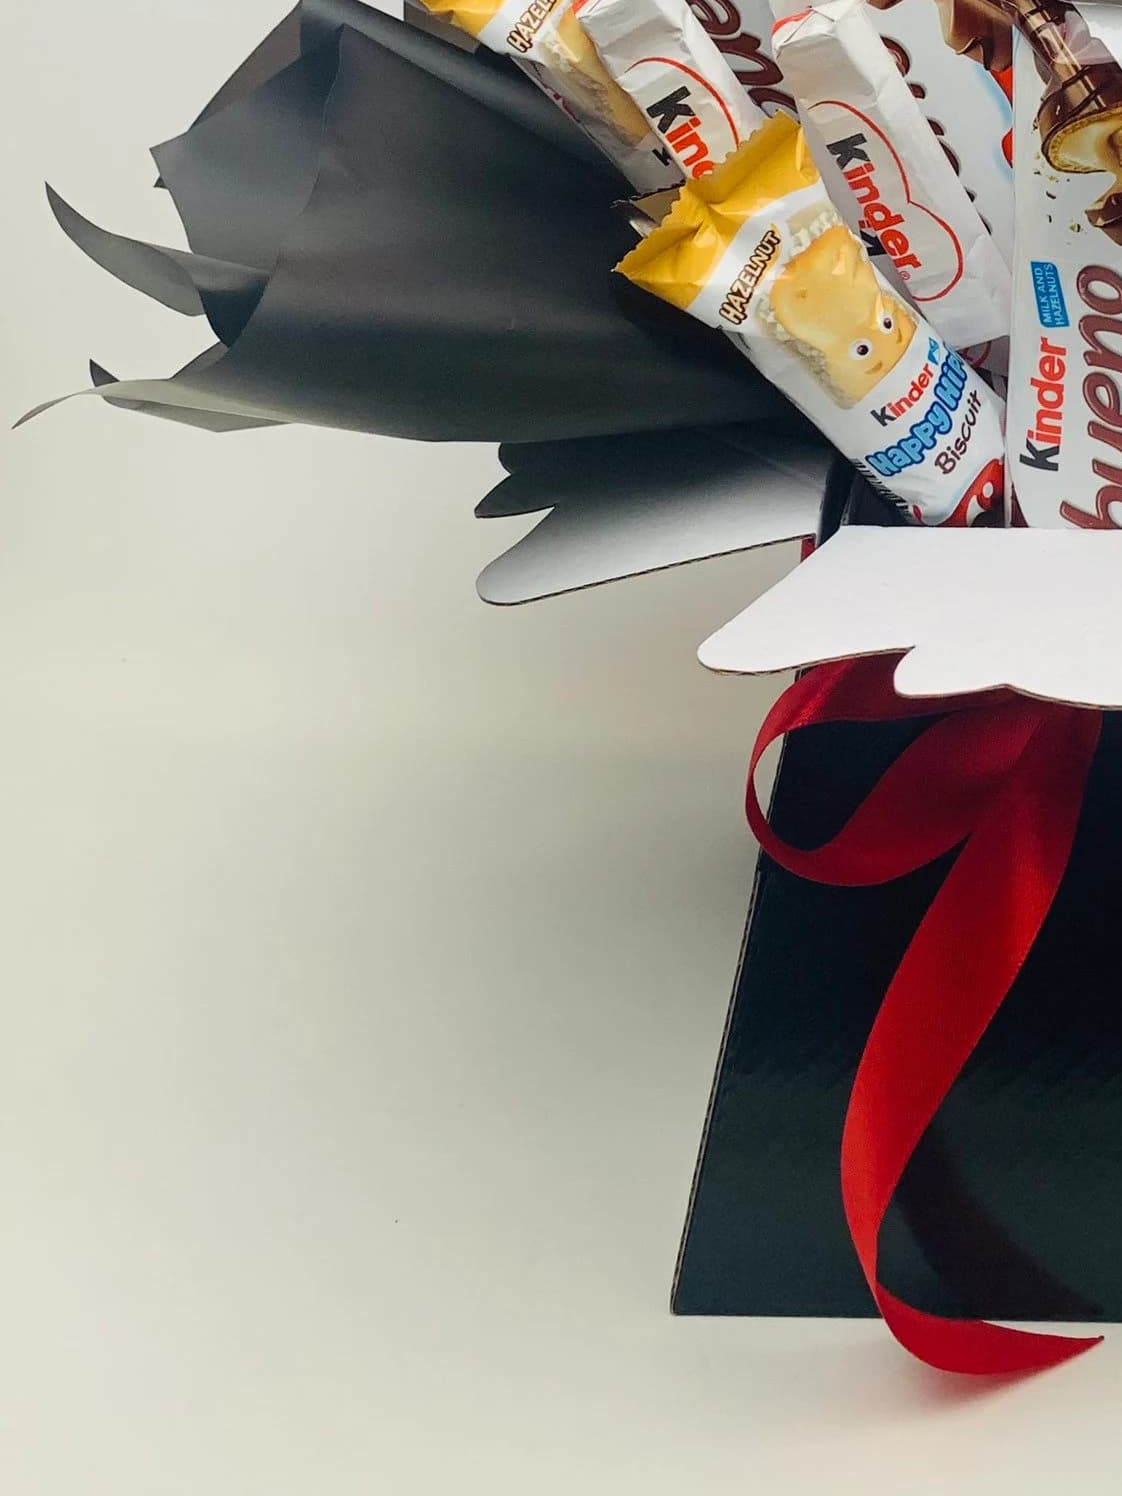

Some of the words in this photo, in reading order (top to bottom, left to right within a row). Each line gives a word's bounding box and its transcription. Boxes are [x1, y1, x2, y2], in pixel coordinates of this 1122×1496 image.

[718, 230, 781, 326] HAZELNUT
[1034, 267, 1047, 293] AND
[1040, 295, 1053, 323] MILK
[1044, 263, 1065, 326] HAZELNUTS
[864, 400, 952, 477] Happy
[934, 389, 982, 474] Biscuit
